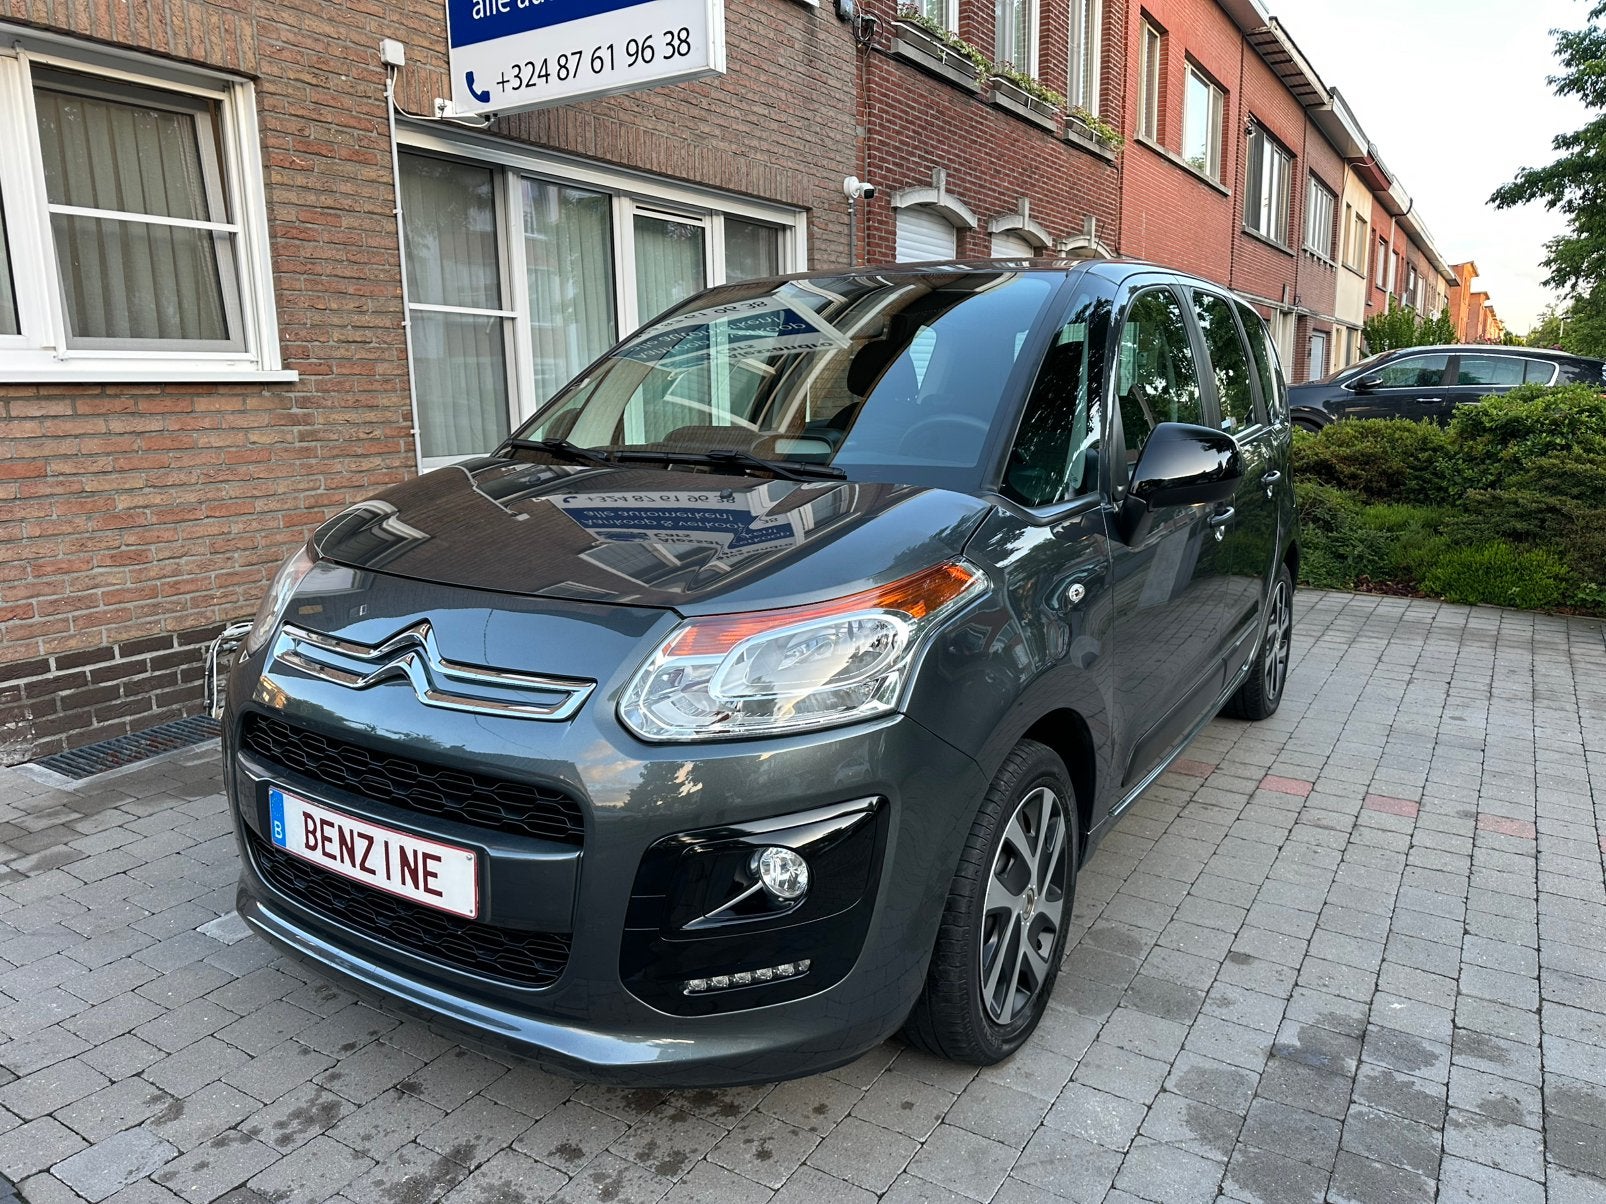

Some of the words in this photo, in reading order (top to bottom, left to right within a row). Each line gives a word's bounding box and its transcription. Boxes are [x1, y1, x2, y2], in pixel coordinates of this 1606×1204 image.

[496, 58, 550, 93] +324
[556, 50, 583, 81] 87
[590, 43, 615, 74] 61
[626, 34, 655, 67] 96
[662, 27, 691, 60] 38
[274, 820, 283, 839] B
[302, 810, 443, 898] BENZINE
